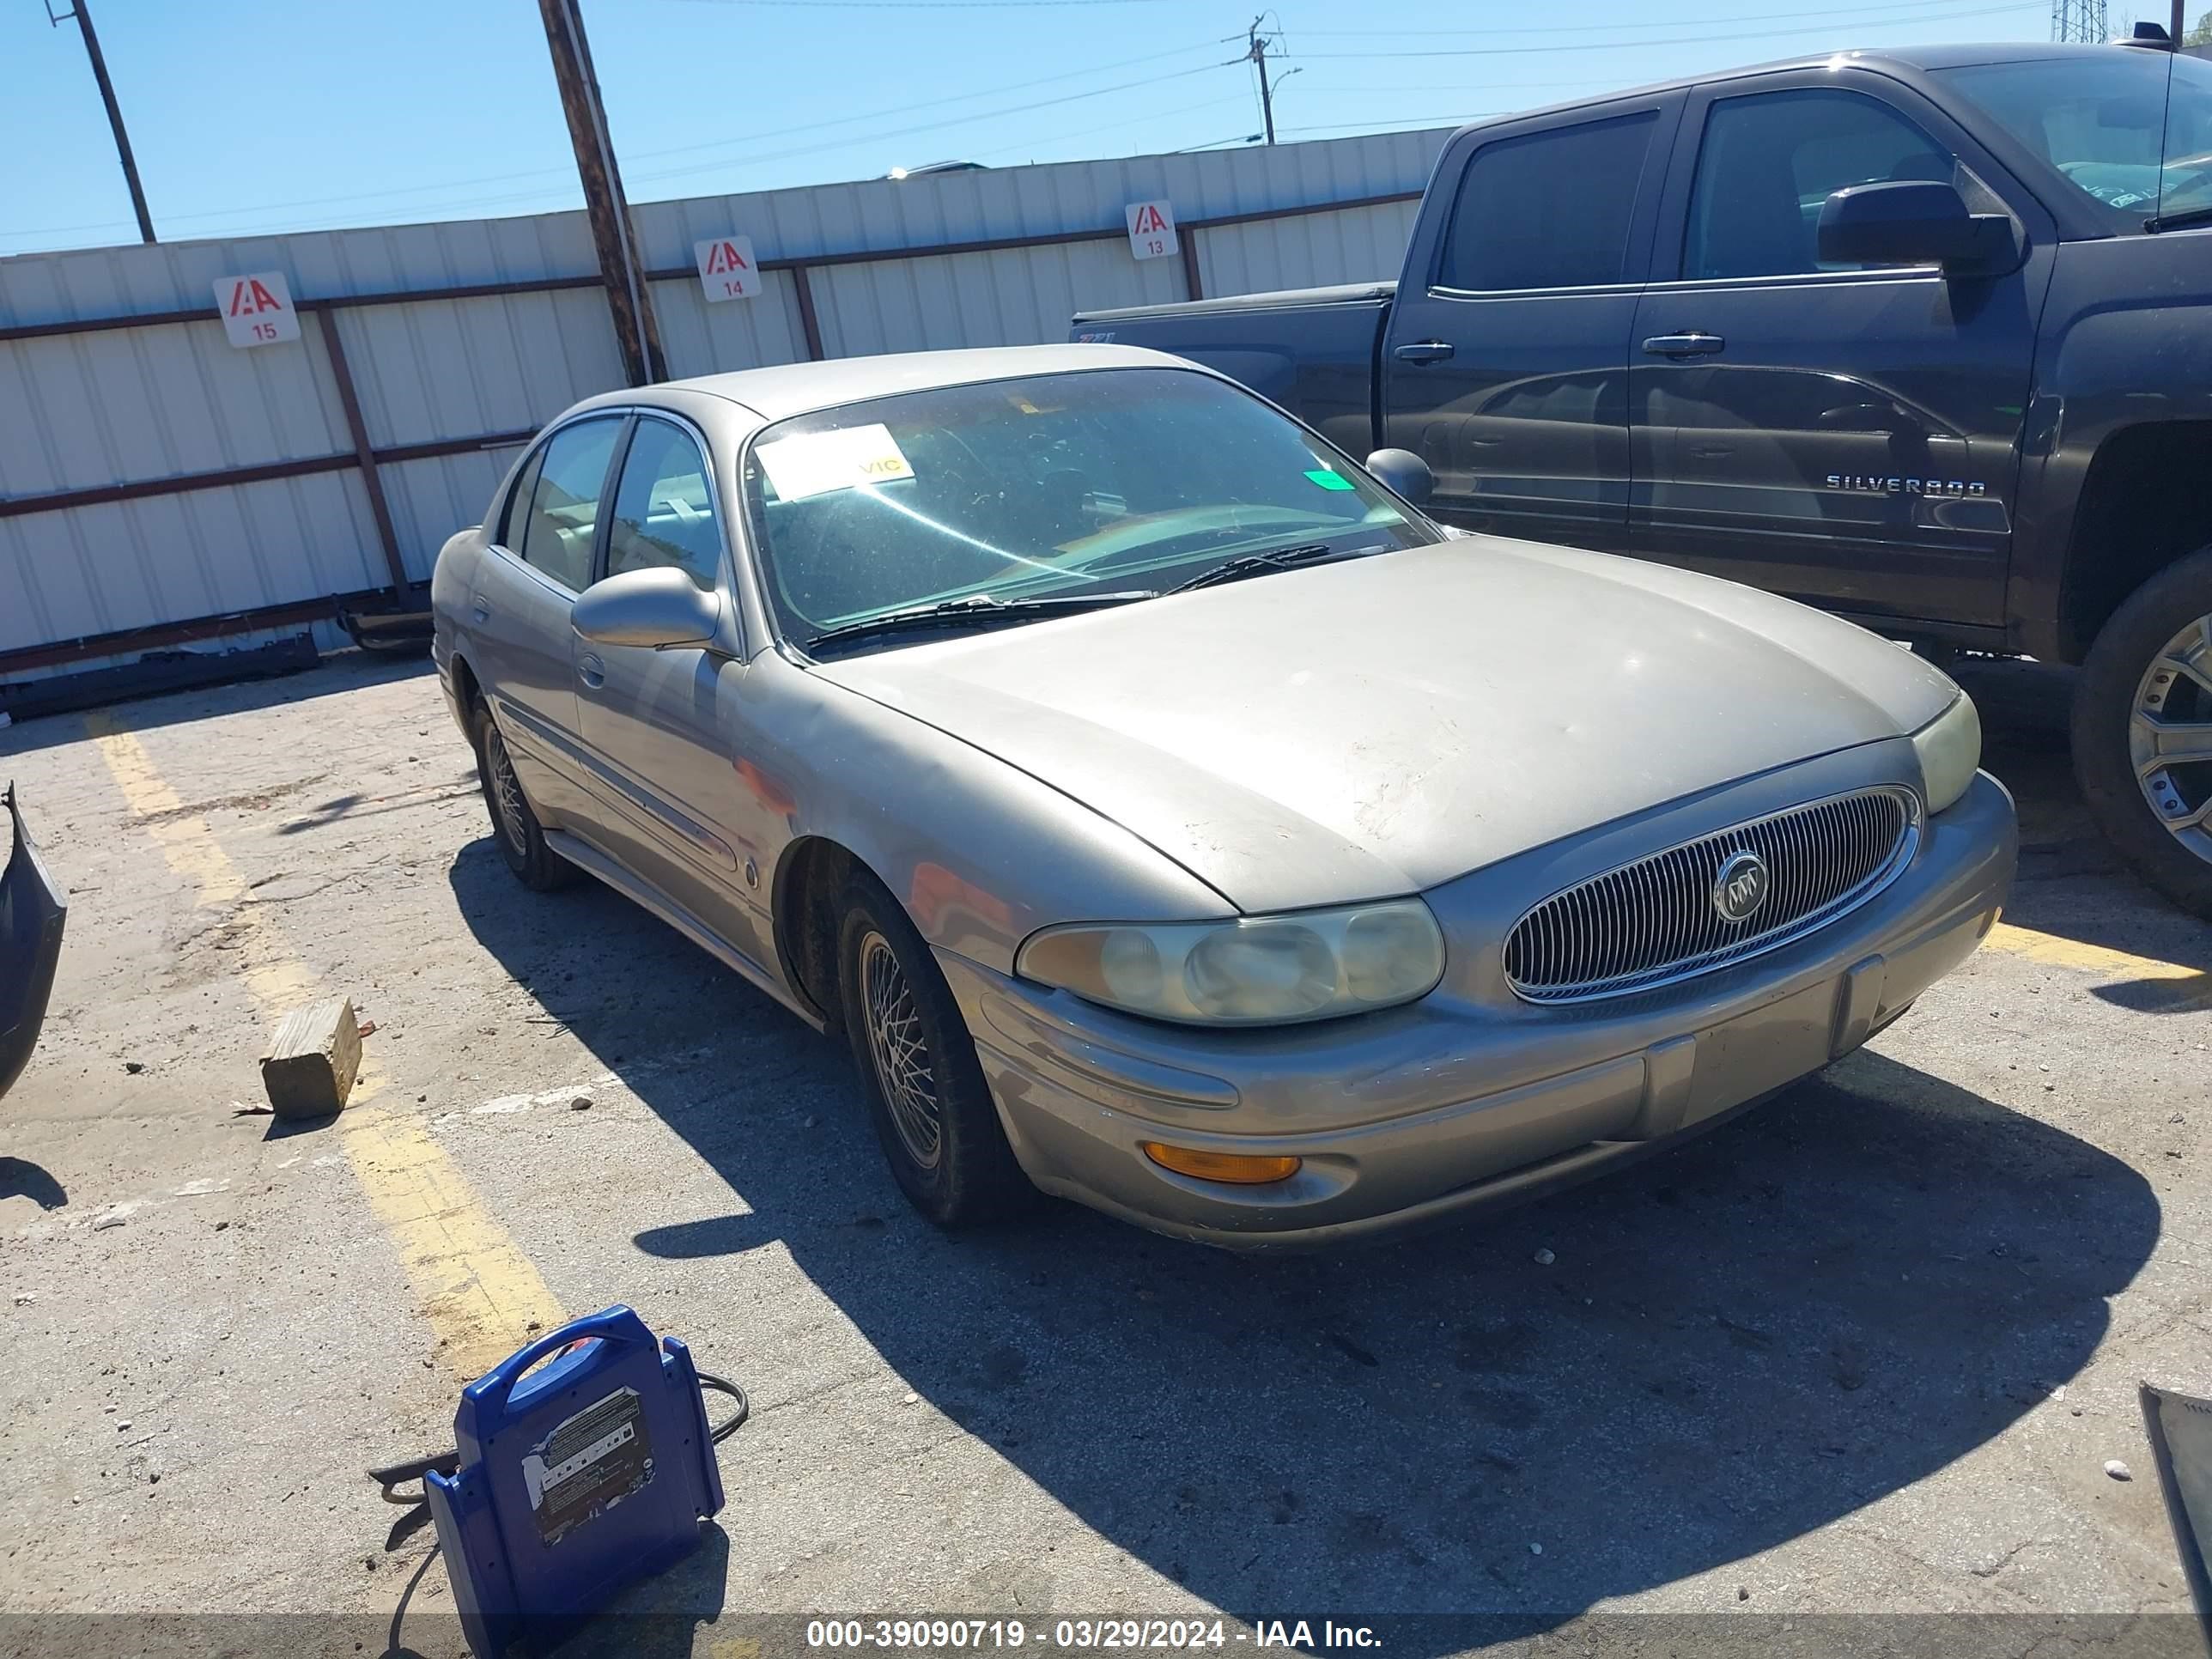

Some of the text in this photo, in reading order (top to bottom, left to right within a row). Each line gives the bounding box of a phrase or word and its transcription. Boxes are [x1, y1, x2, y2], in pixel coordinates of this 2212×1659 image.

[1147, 240, 1164, 255] 13
[724, 281, 743, 296] 14
[252, 323, 277, 341] 15
[1826, 474, 1986, 497] SILVERADO
